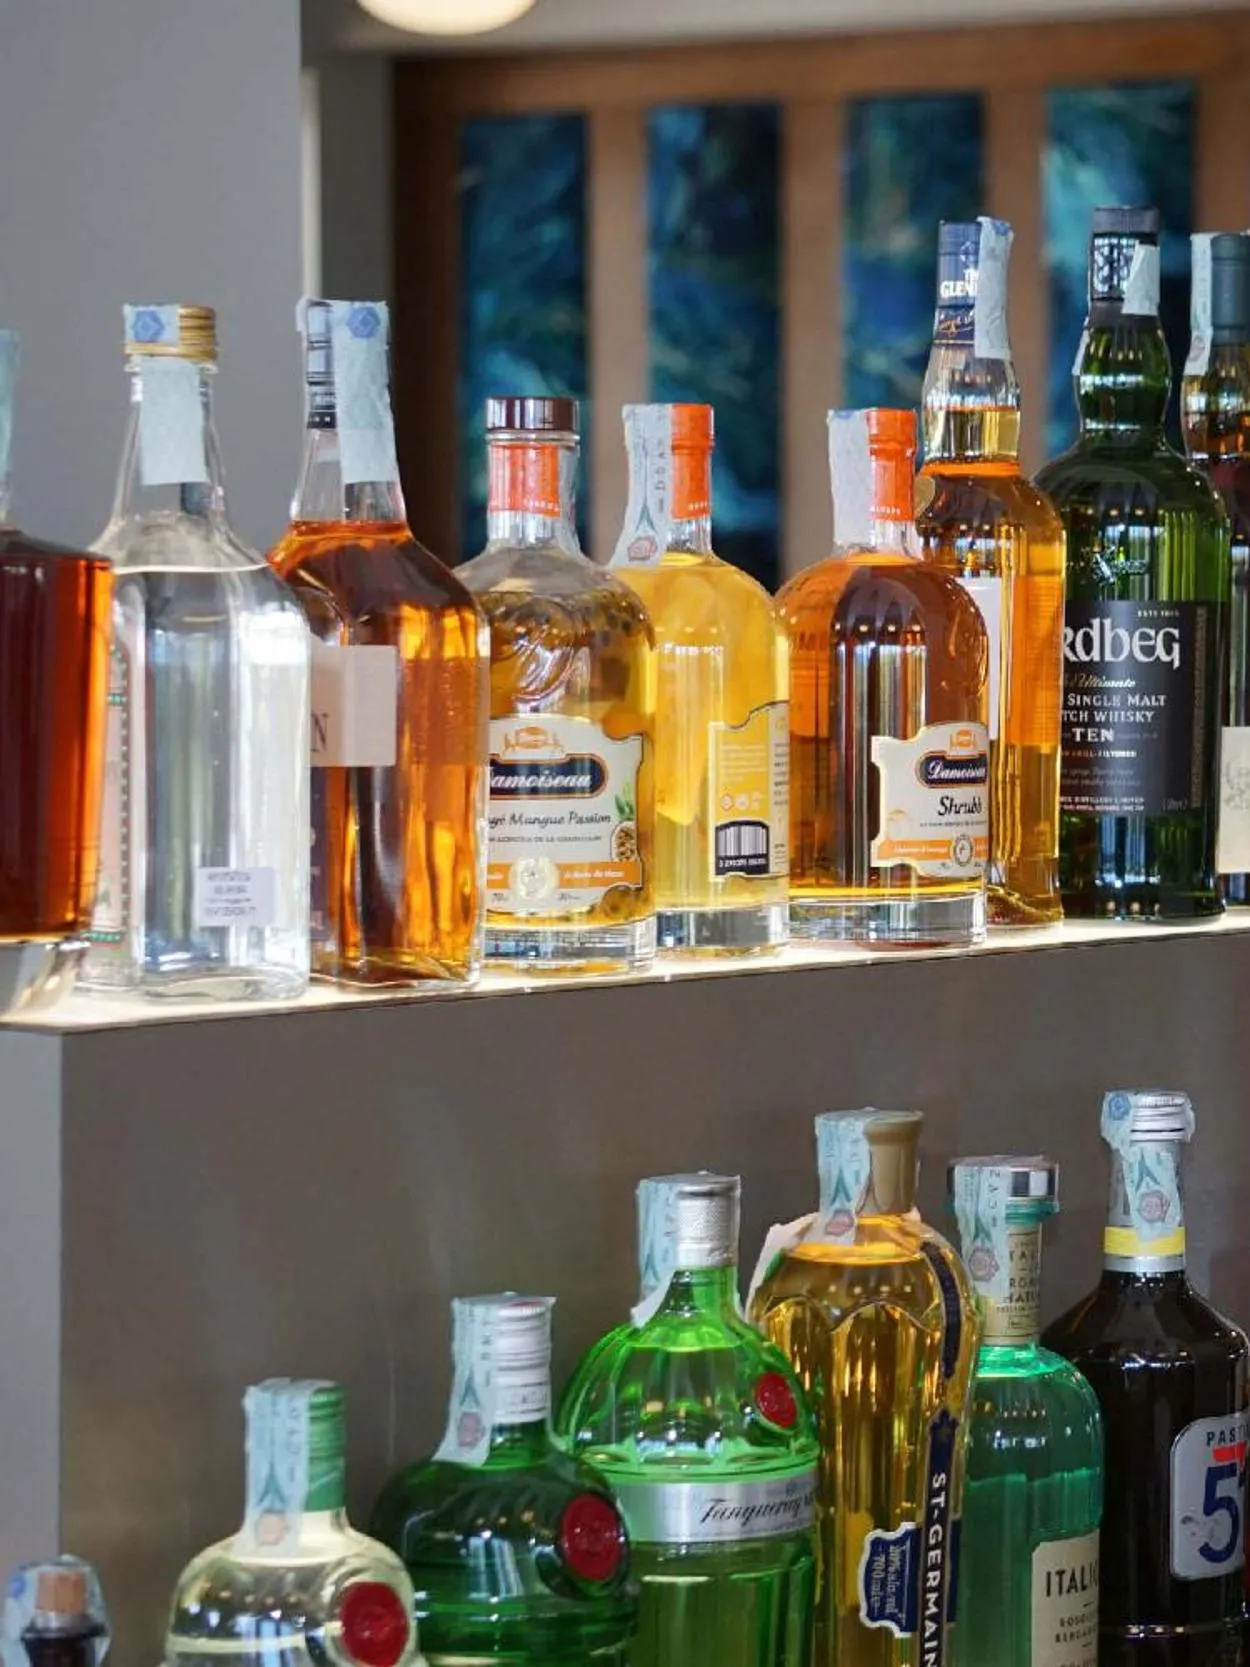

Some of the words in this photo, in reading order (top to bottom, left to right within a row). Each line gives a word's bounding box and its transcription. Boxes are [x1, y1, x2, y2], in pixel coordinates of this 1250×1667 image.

[1067, 692, 1121, 706] SINGLE
[1127, 694, 1167, 706] MALT
[1094, 710, 1155, 723] WHISKY
[1072, 727, 1115, 742] TEN
